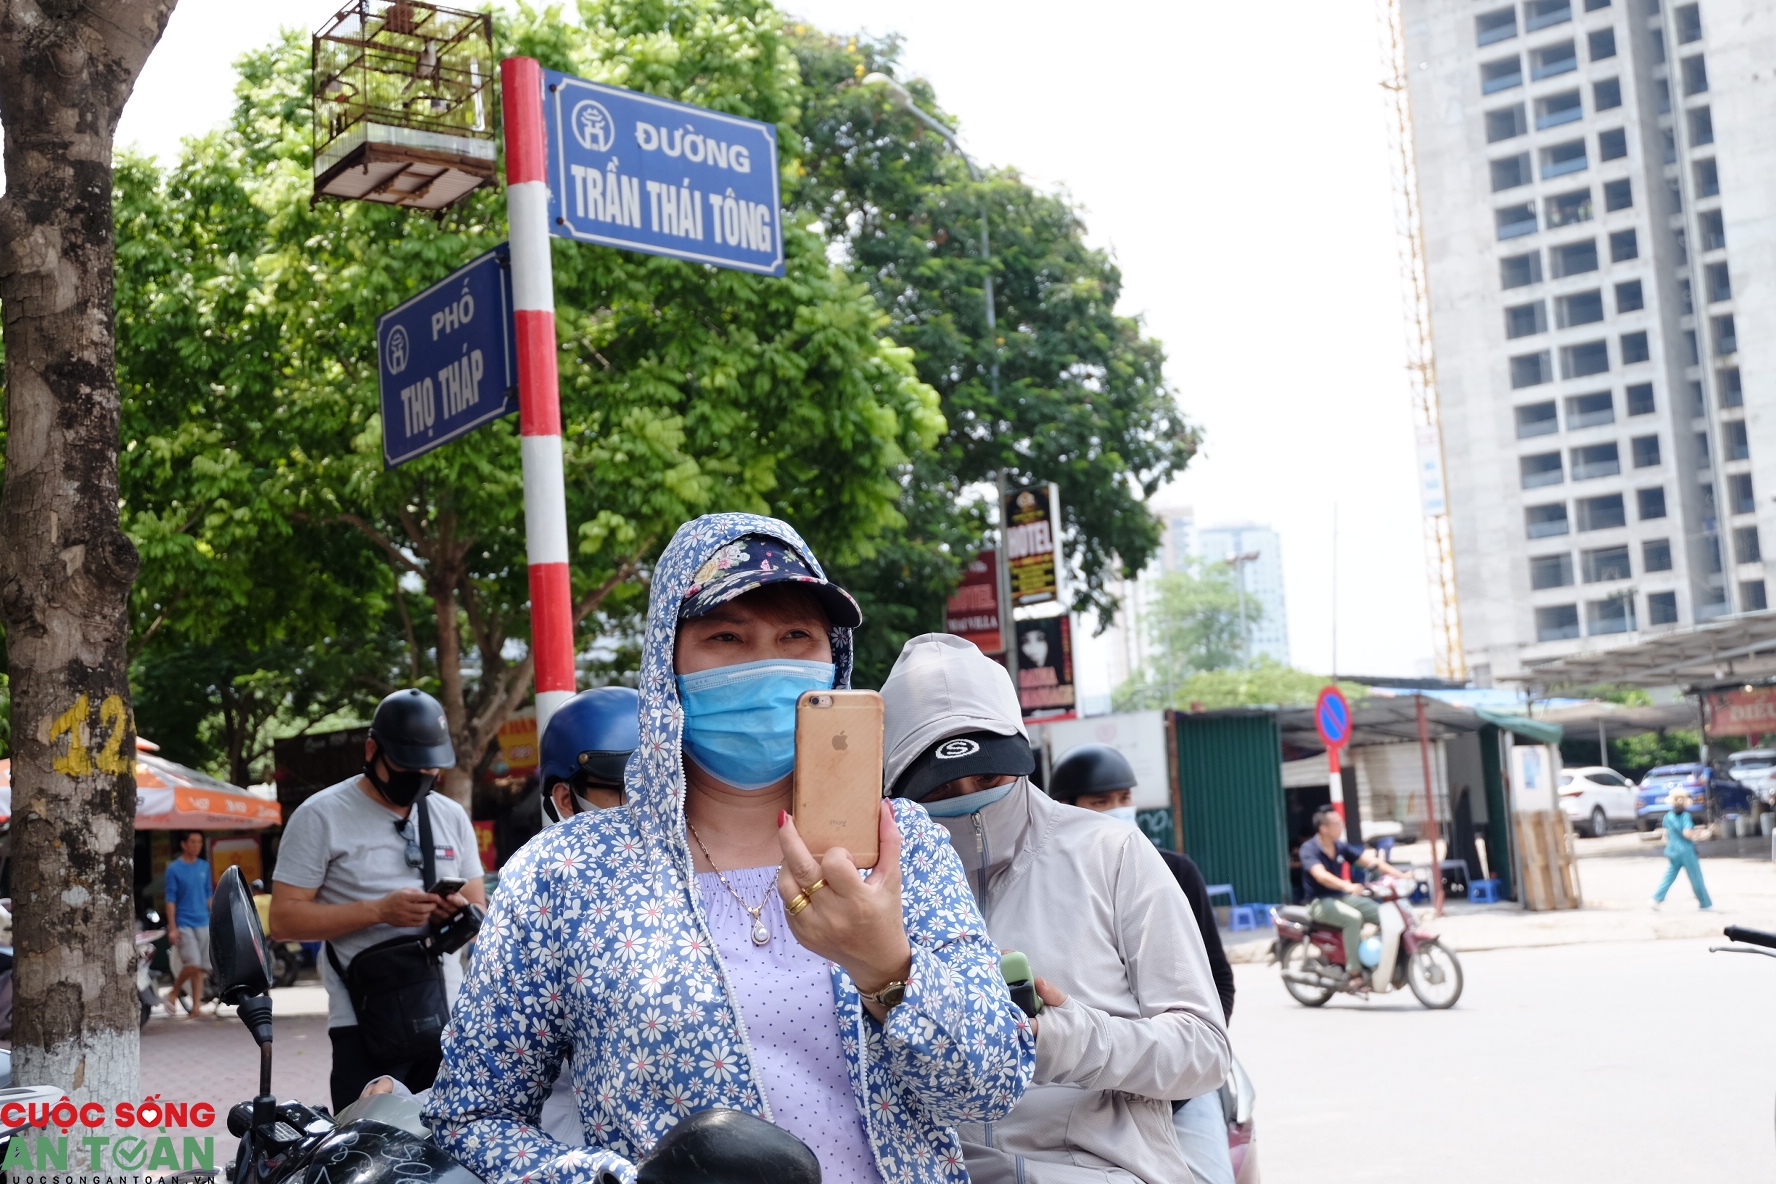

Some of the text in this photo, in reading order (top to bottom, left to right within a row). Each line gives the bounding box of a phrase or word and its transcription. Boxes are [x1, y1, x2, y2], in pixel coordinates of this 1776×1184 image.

[635, 120, 751, 173] ĐƯỜNG
[570, 156, 772, 252] TRẦN THÁI TÔNG
[431, 277, 475, 341] PHỐ
[401, 342, 484, 438] THỌ THÁP
[1007, 520, 1053, 559] HOTEL
[50, 690, 127, 776] 12
